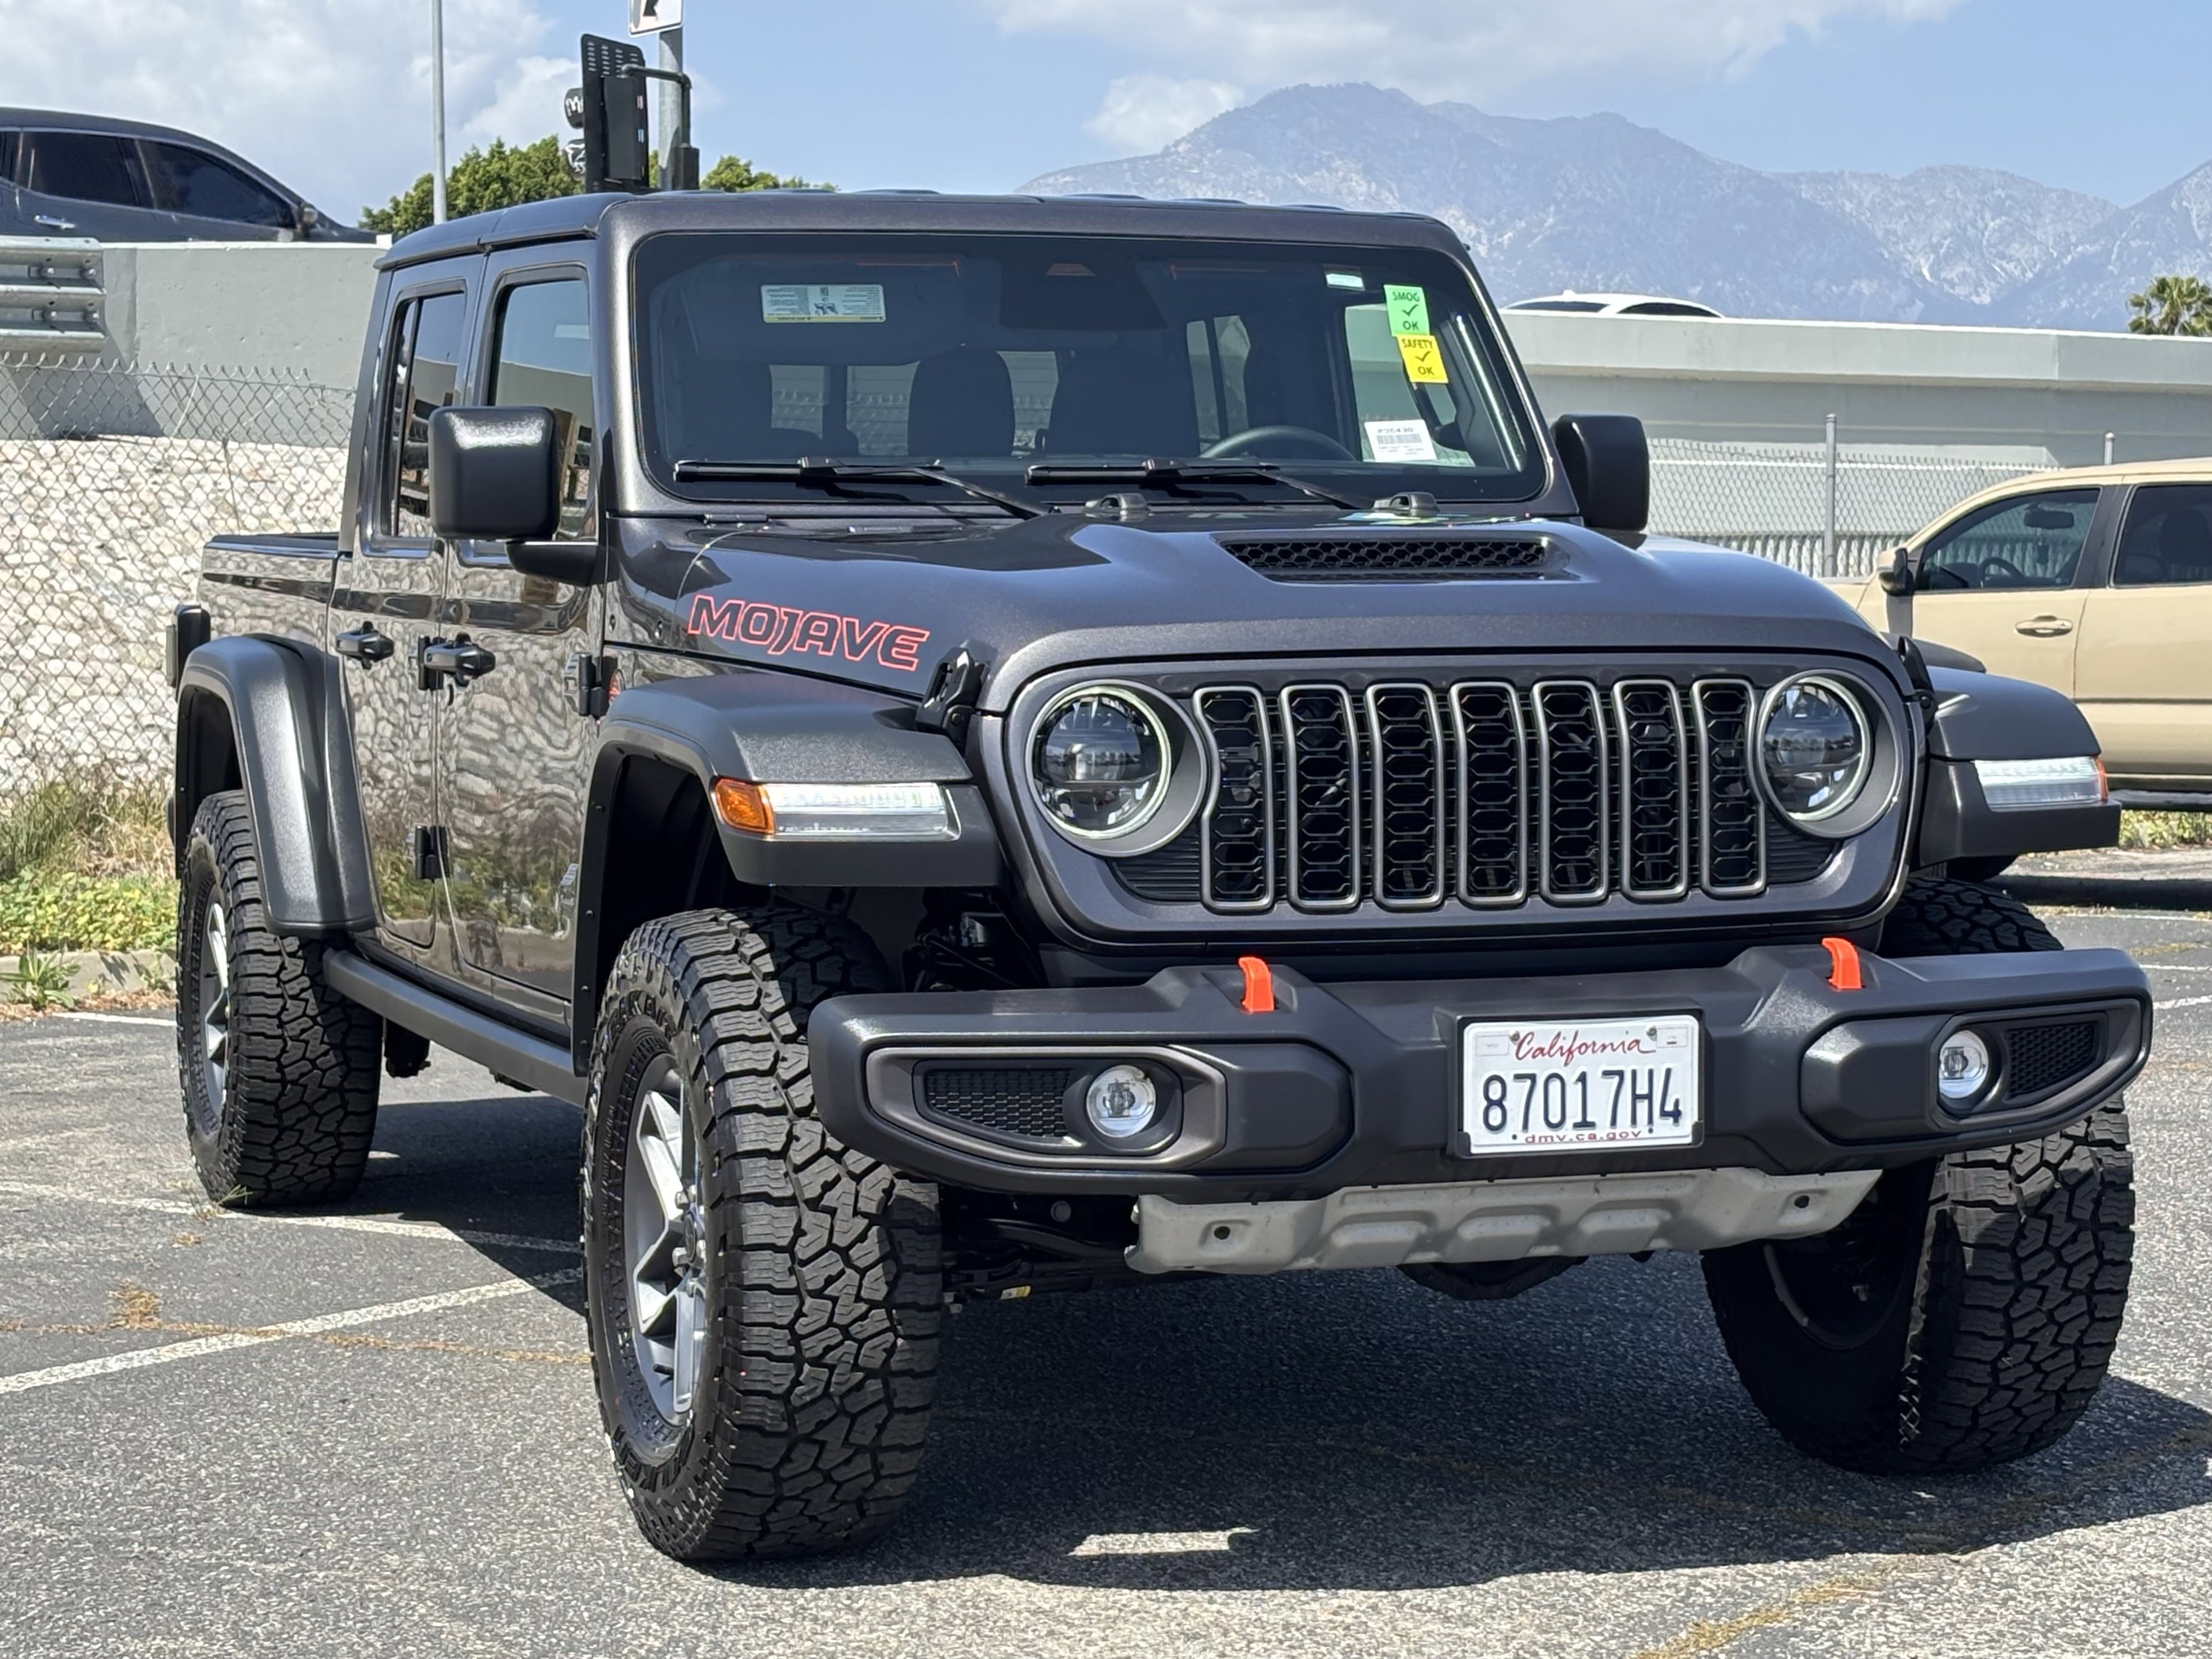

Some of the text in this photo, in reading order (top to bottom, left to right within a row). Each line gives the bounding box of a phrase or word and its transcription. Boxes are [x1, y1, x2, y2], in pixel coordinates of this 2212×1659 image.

[1392, 291, 1420, 302] SMOG
[1402, 320, 1420, 331] OK
[1401, 338, 1433, 349] SAFETY
[1418, 366, 1435, 376] OK
[687, 595, 930, 672] MOJAVE
[1514, 1030, 1656, 1067] California
[1482, 1067, 1682, 1133] 87017H4
[1524, 1129, 1642, 1144] dmv.ca.gov
